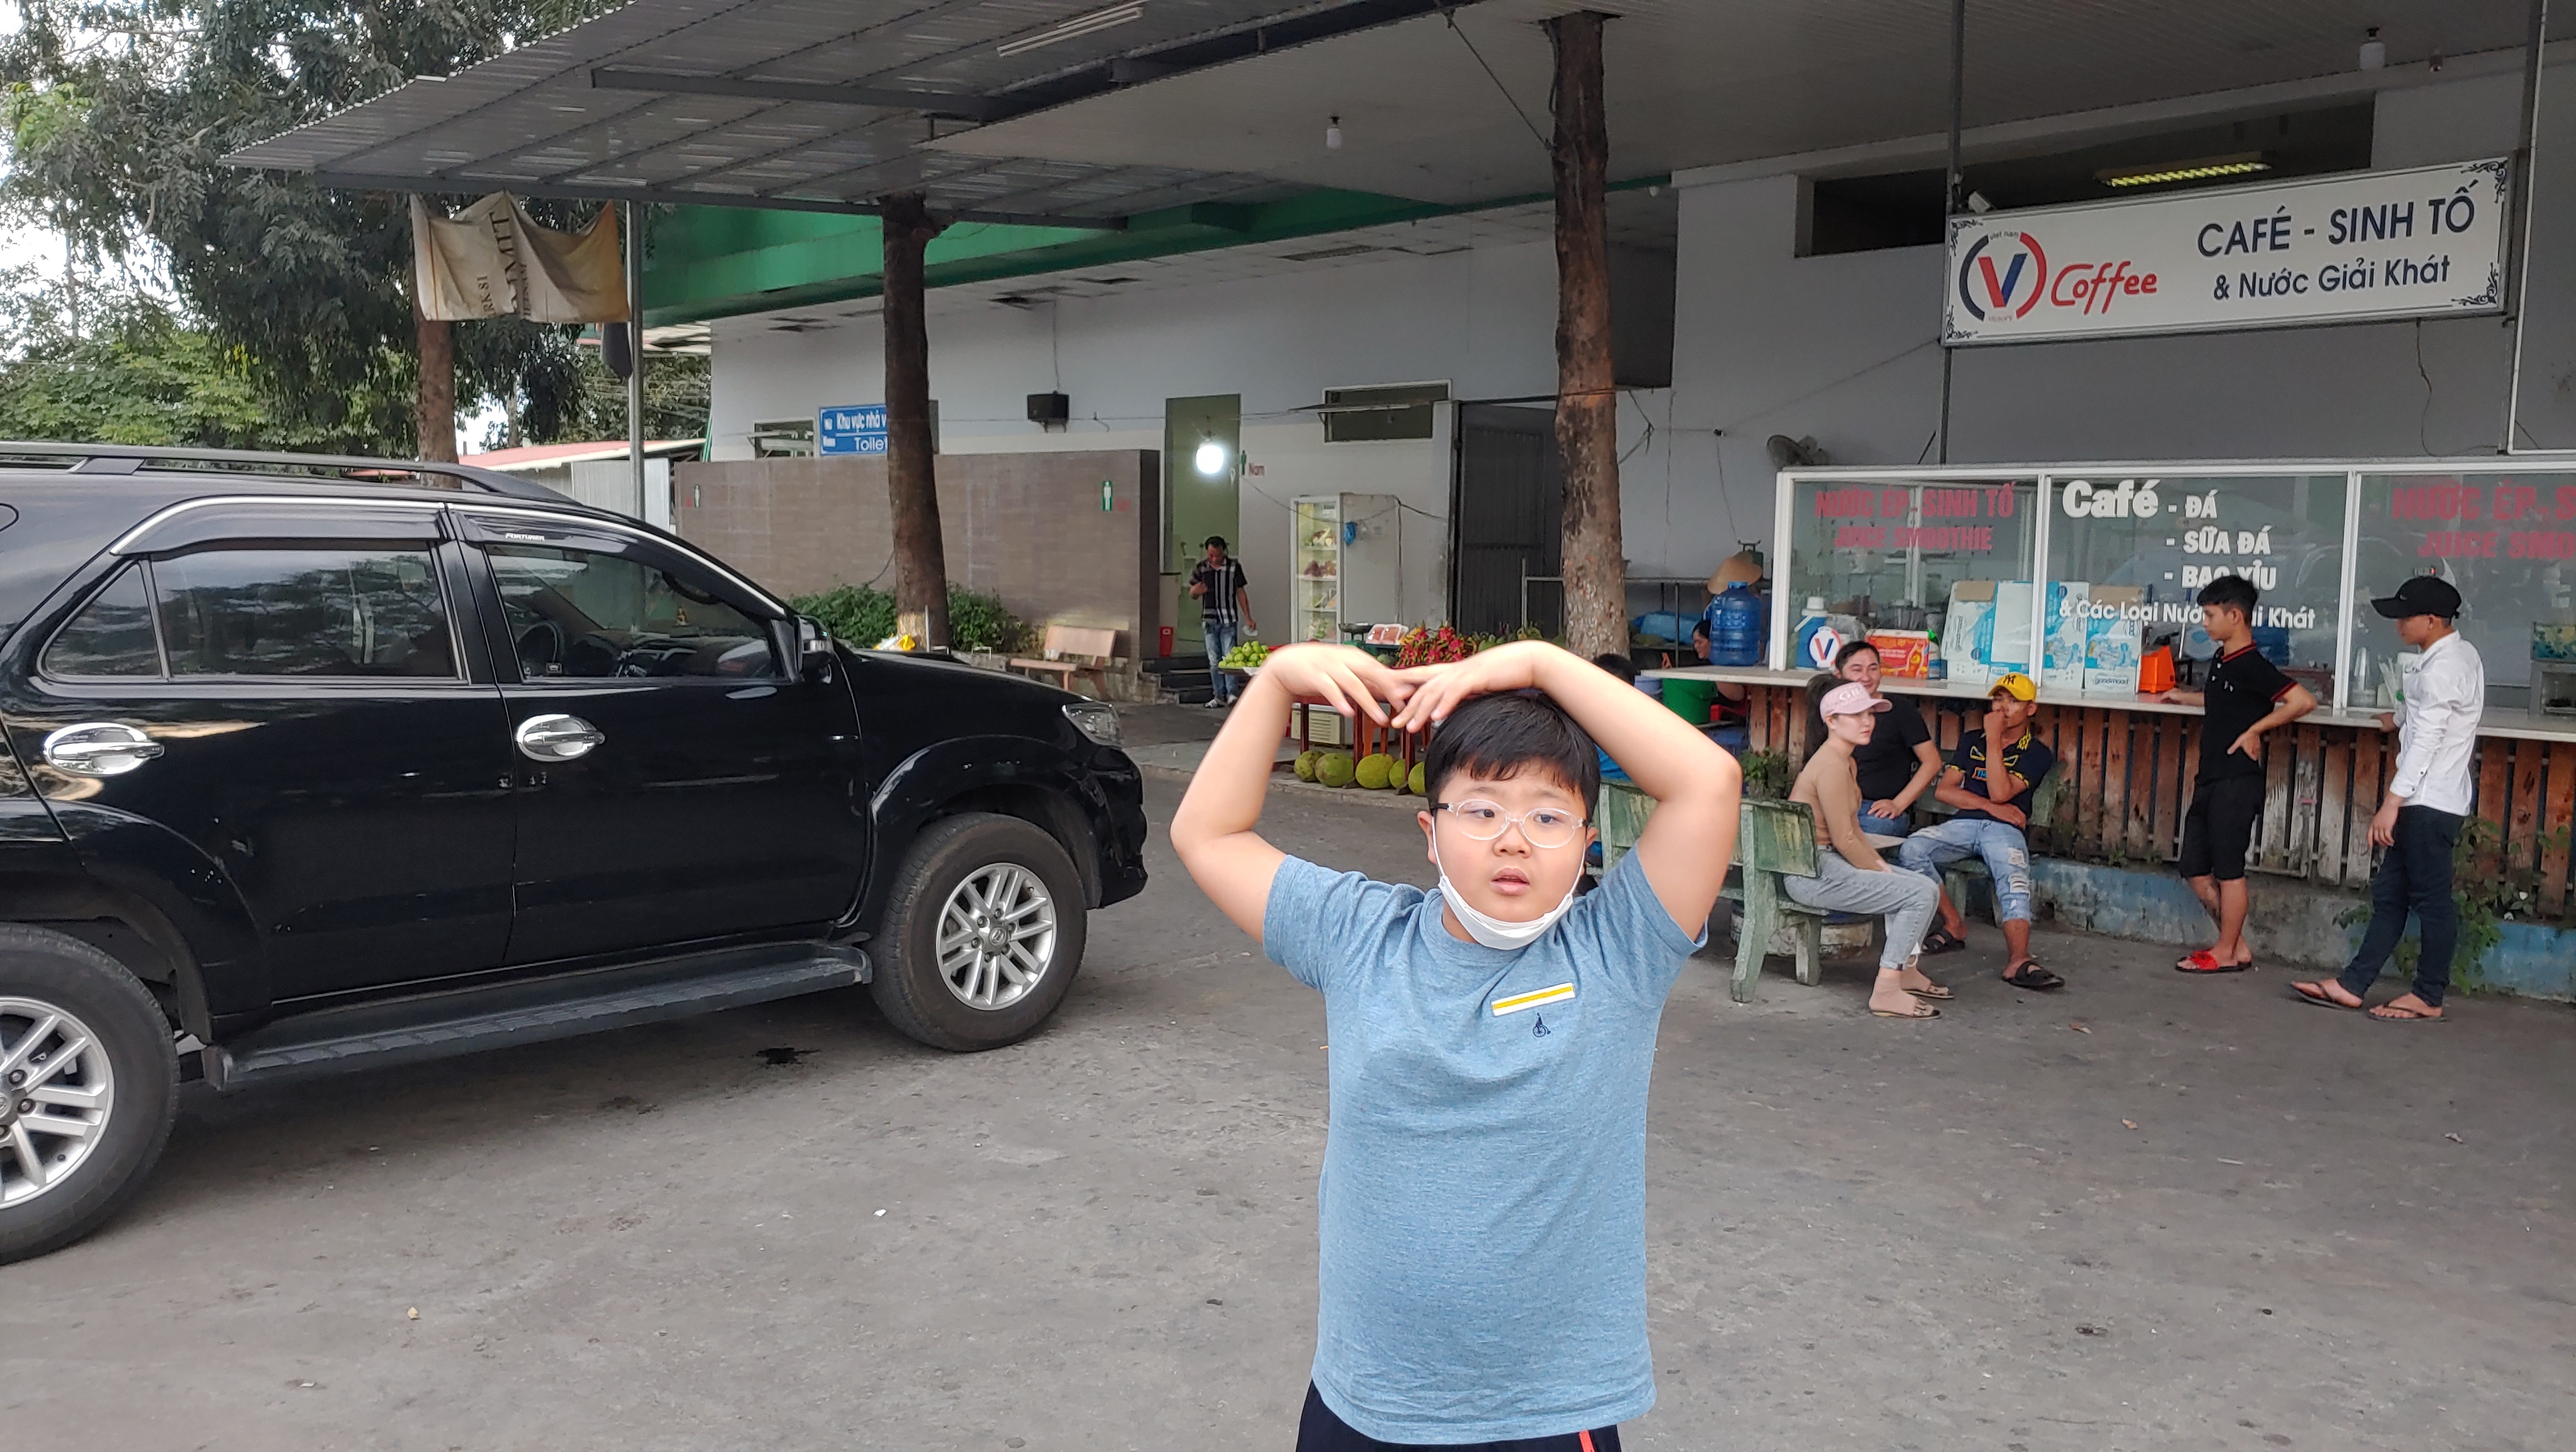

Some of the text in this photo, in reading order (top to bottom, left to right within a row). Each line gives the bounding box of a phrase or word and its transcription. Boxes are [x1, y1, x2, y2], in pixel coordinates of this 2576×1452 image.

[2198, 205, 2291, 257] CAFÉ
[2329, 201, 2414, 245] SINH
[2428, 180, 2478, 235] TỐ
[1978, 252, 2028, 308] V
[2051, 261, 2157, 316] Coffee
[2213, 254, 2450, 300] & Nước Giải Khát
[1815, 486, 1874, 518] NƯỚC
[1922, 489, 1977, 518] SINH
[1986, 481, 2016, 518] TỐ
[2062, 479, 2161, 518] Café
[2185, 489, 2218, 519] ĐÁ
[2393, 480, 2481, 520] NƯỚC
[2493, 479, 2536, 520] ÉP
[1834, 527, 1992, 550] JUICE SMOOTHIE
[2183, 526, 2230, 555] SỮA
[2237, 525, 2272, 555] ĐÁ
[2418, 531, 2499, 559] JUICE
[2077, 599, 2115, 620] Các
[2163, 602, 2204, 624] Nướ
[2269, 604, 2315, 629] Khát
